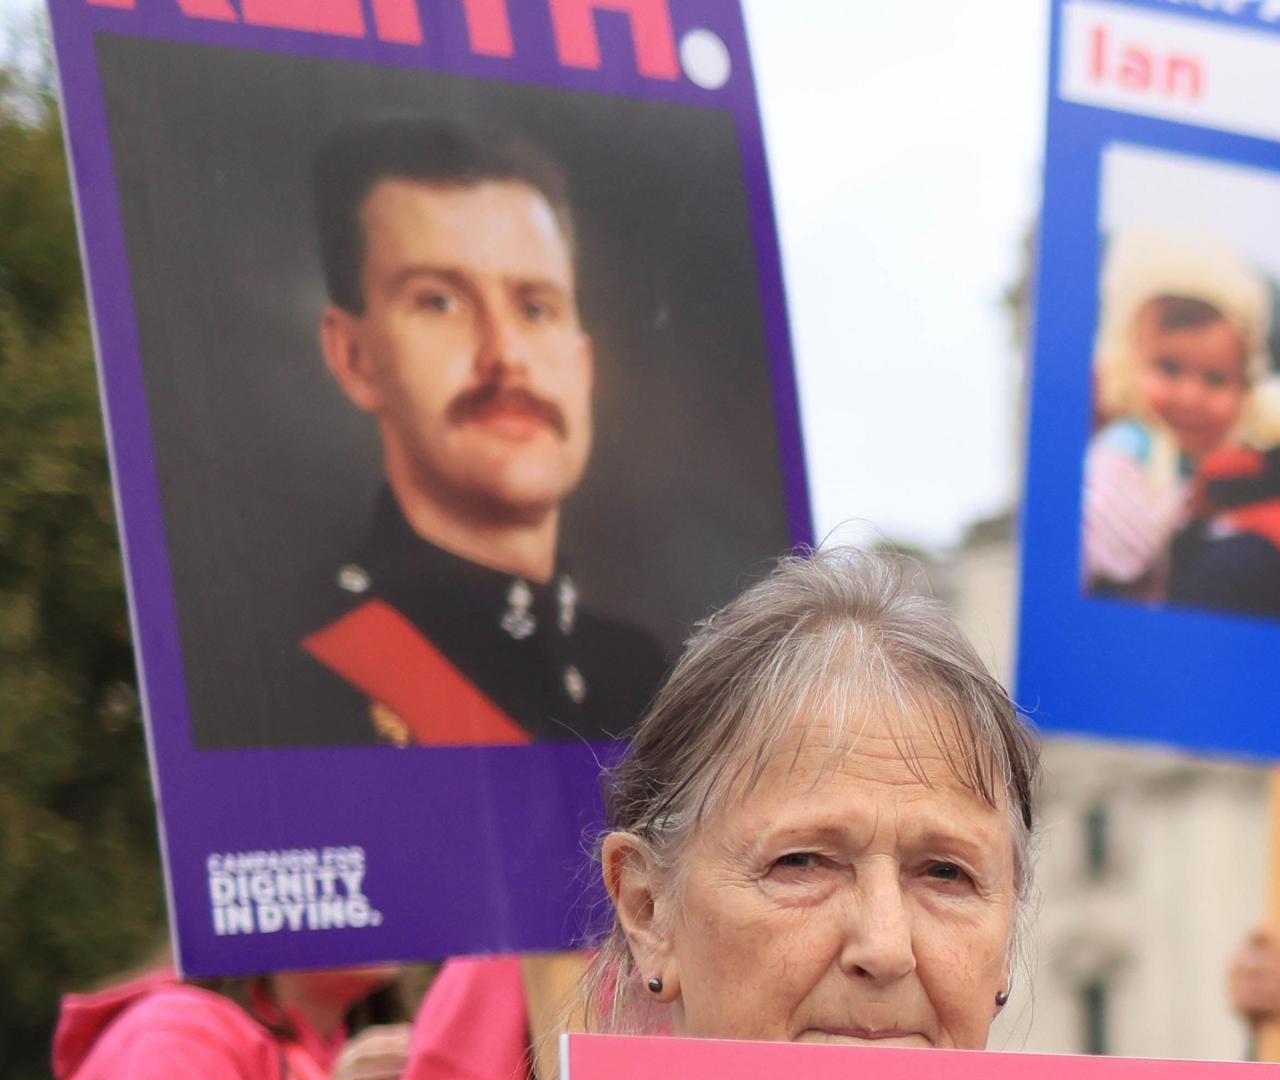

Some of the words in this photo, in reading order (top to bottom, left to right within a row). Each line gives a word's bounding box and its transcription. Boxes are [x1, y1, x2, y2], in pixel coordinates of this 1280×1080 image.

[1089, 25, 1205, 102] Ian
[210, 868, 365, 907] DIGNITY
[213, 902, 254, 936] IN
[256, 894, 383, 934] DYING.
